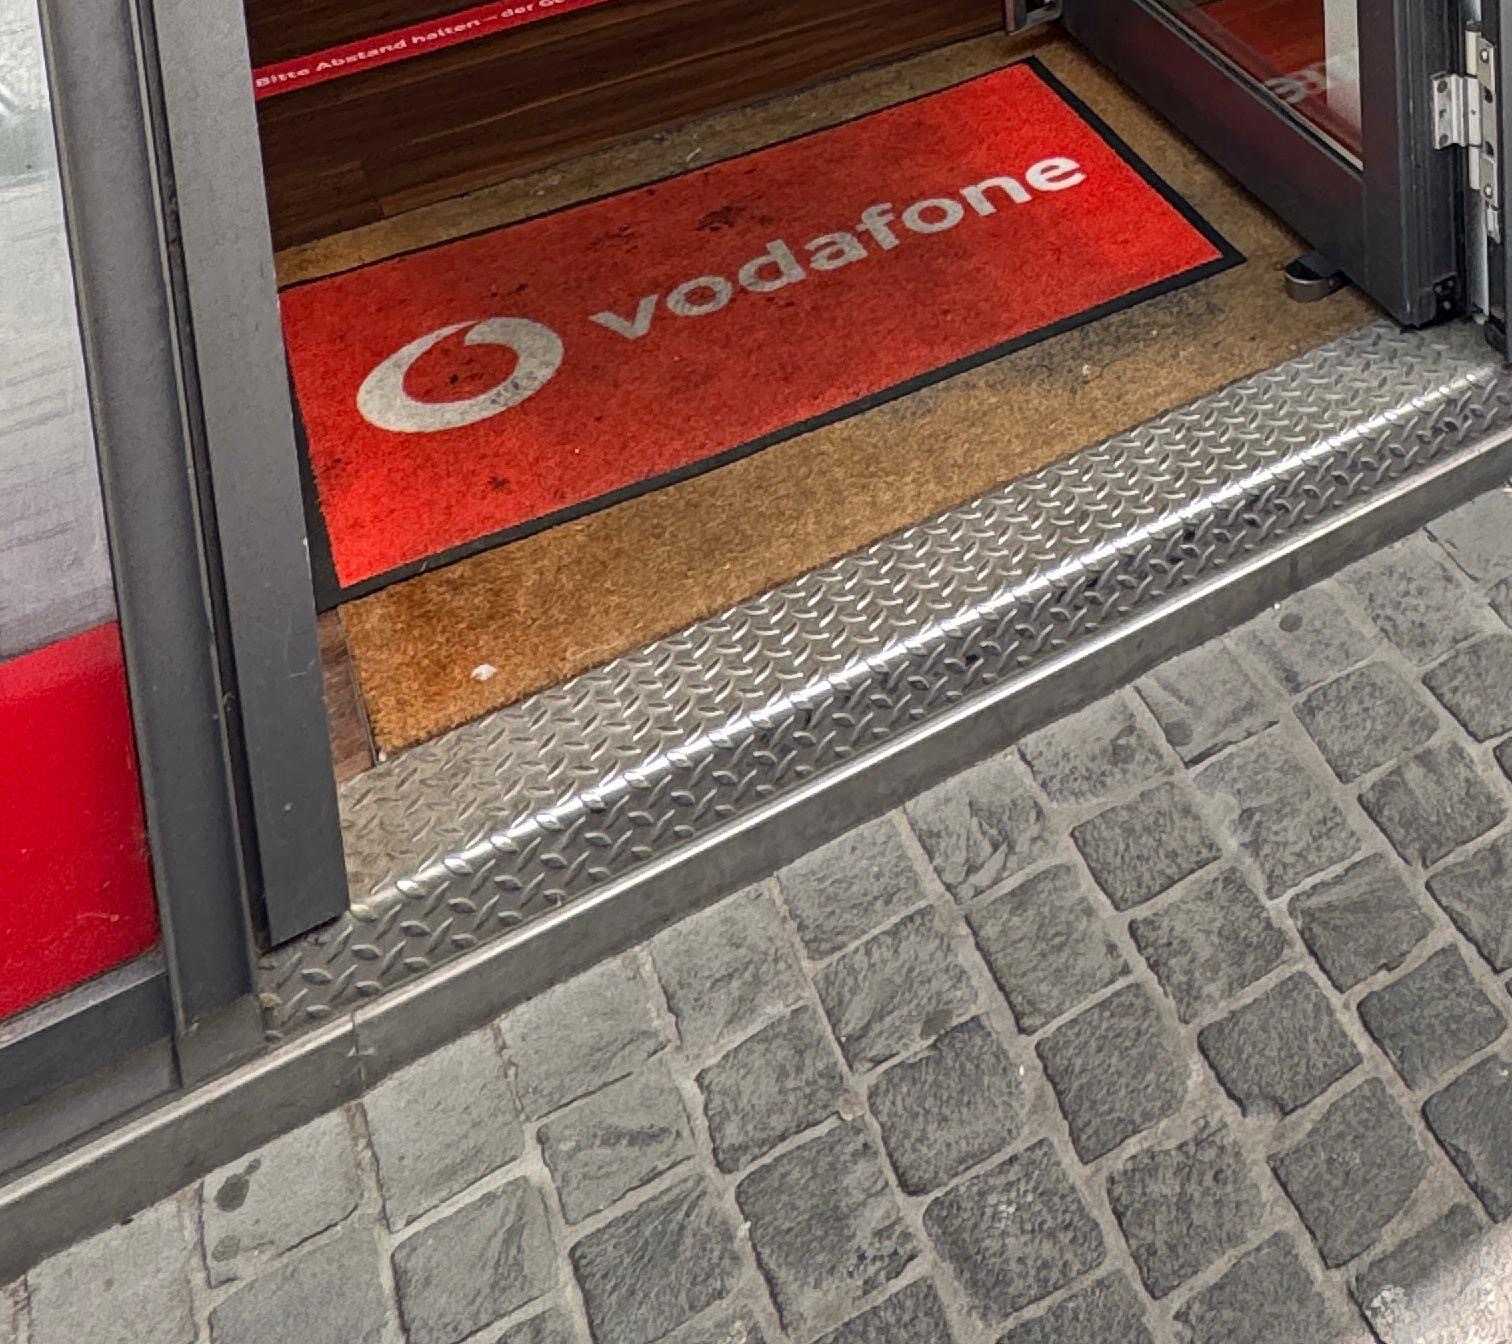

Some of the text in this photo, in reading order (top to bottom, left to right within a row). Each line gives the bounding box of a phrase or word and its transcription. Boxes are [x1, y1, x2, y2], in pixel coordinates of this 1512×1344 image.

[255, 66, 310, 89] Bitte
[315, 38, 408, 73] Abstand
[411, 17, 483, 45] halten
[500, 2, 534, 19] der
[588, 154, 1087, 344] vodafone
